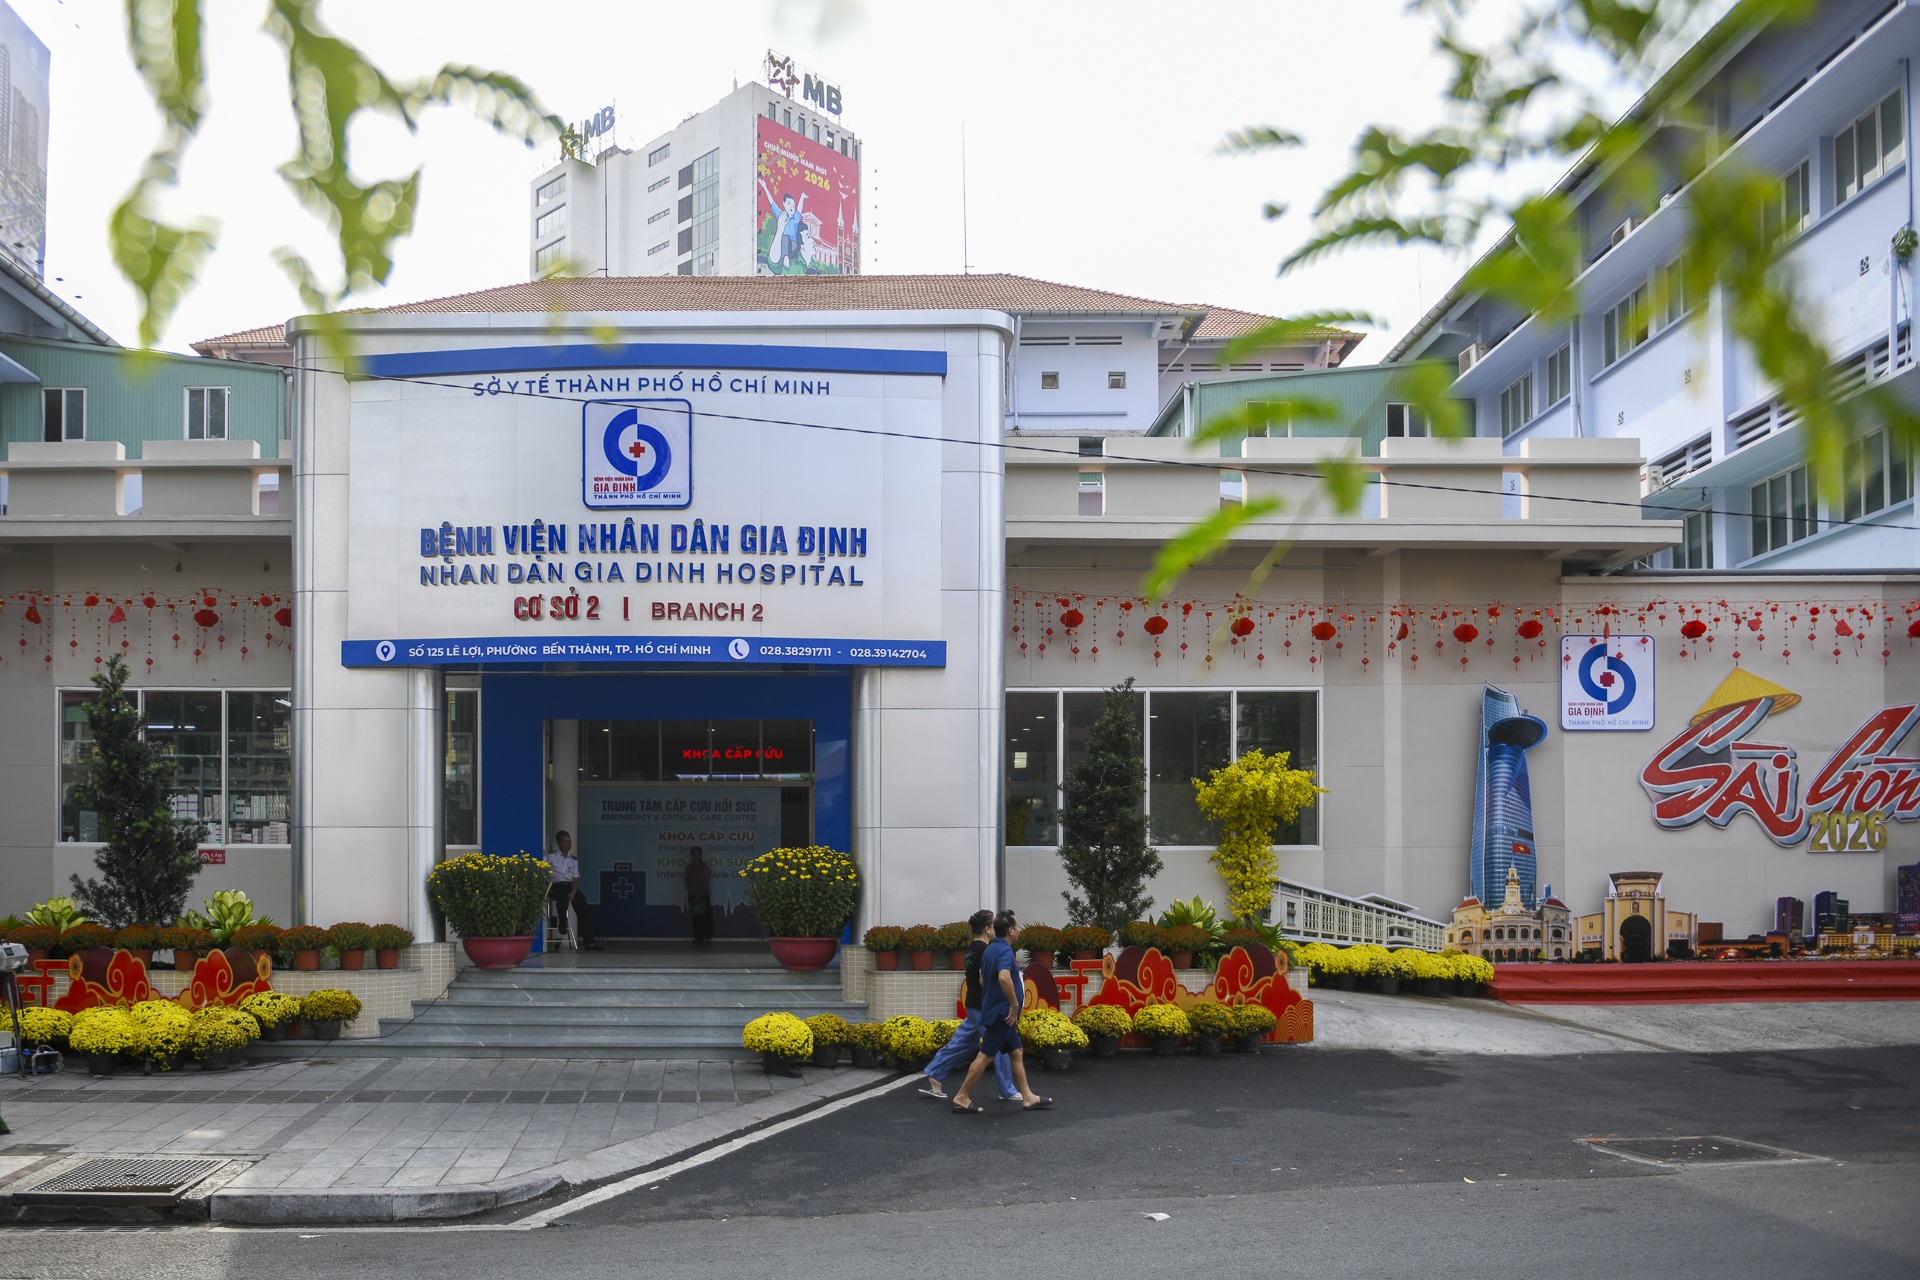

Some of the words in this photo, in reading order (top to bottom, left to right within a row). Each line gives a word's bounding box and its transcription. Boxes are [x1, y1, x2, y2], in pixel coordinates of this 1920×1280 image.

[803, 73, 842, 115] MB
[584, 106, 615, 145] MB
[804, 169, 831, 191] 2026
[473, 375, 501, 396] SỞ
[507, 380, 519, 395] Y
[525, 373, 550, 394] TẾ
[555, 374, 630, 393] THÀNH
[638, 371, 684, 392] PHỐ
[692, 371, 722, 392] HỒ
[730, 375, 767, 394] CHÍ
[774, 379, 830, 395] MINH
[593, 483, 610, 493] GIA
[612, 483, 636, 494] ĐỊNH
[420, 521, 495, 563] BỆNH
[502, 518, 567, 561] VIỆN
[578, 517, 660, 554] NHÂN
[671, 518, 729, 554] DÂN
[740, 524, 788, 555] GIA
[797, 525, 867, 562] ĐỊNH
[420, 563, 498, 586] NHAN
[507, 562, 564, 583] DAN
[574, 561, 625, 583] GIA
[635, 561, 705, 583] DINH
[717, 562, 864, 586] HOSPITAL
[513, 594, 545, 621] CƠ
[549, 586, 581, 620] SỞ
[586, 595, 601, 620] 2
[651, 602, 745, 621] BRANCH
[751, 603, 764, 622] 2
[408, 643, 425, 658] SỐ
[426, 647, 444, 657] 125
[446, 645, 460, 657] LÊ
[462, 646, 484, 658] LỢI,
[486, 643, 537, 656] PHƯỜNG
[542, 641, 566, 655] BẾN
[568, 641, 613, 656] THÀNH,
[615, 644, 633, 655] TP.
[635, 641, 653, 654] HỒ
[656, 642, 678, 655] CHÍ
[679, 645, 711, 655] MINH
[760, 645, 832, 658] 028.38291711
[850, 648, 927, 660] 028.39142704
[1568, 708, 1582, 716] GIA
[1584, 707, 1605, 718] ĐỊNH
[683, 749, 721, 759] KHOA
[725, 745, 753, 759] CẤP
[755, 745, 784, 759] CỨU
[601, 800, 637, 812] TRUNG
[639, 798, 662, 812] TÂM
[665, 797, 687, 812] CẤP
[690, 798, 711, 812] CỨU
[735, 798, 757, 812] SỨC
[724, 814, 757, 822] CENTER
[658, 832, 695, 841] KHOA
[698, 828, 725, 841] CẤP
[728, 829, 755, 841] CỨU
[657, 870, 686, 879] Inten
